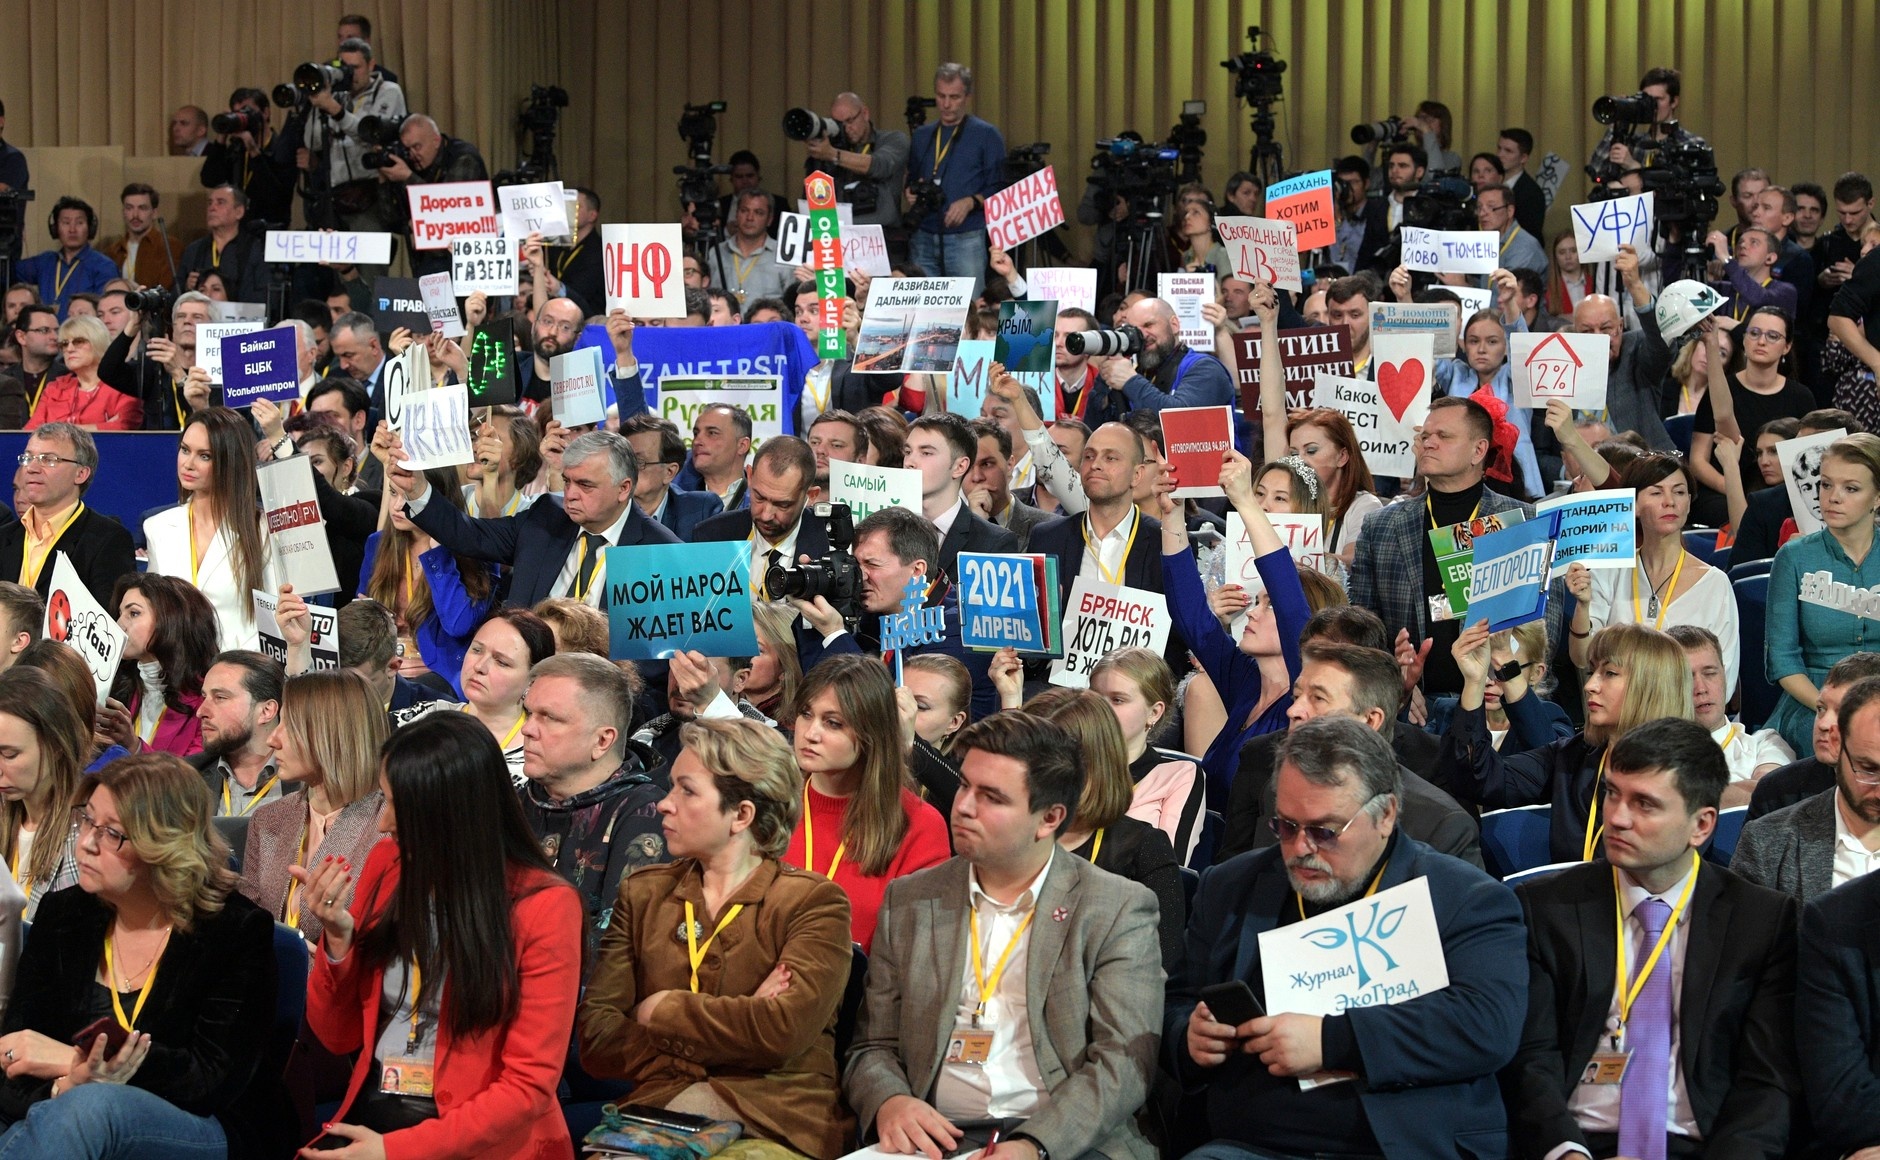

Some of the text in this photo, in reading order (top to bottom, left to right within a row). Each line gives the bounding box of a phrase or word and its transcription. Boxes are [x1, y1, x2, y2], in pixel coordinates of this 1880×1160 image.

[984, 165, 1057, 225] ЮЖНАЯ
[1268, 176, 1329, 200] АСТРАХАНЬ
[420, 195, 484, 213] Дорога в
[511, 194, 553, 211] BRICS
[1276, 200, 1320, 220] ХОТИМ
[415, 215, 496, 241] Грузию!!!
[524, 217, 543, 232] TV
[990, 196, 1065, 252] ОСЕТИЯ
[1295, 218, 1329, 235] ШАТЬ
[1573, 196, 1650, 254] УФА
[276, 233, 358, 261] ЧЕЧНЯ
[453, 239, 506, 256] НОВАЯ
[842, 236, 884, 261] УРГАН
[1404, 247, 1439, 266] СЛОВО
[1442, 241, 1498, 259] ТЮМЕНЬ
[454, 258, 513, 281] ГАЗЕТА
[605, 241, 671, 299] ОНФ
[1237, 244, 1278, 285] ДВ
[818, 216, 839, 351] БЕЛРУСИНФО
[892, 279, 950, 291] РАЗВИВАЕМ
[1170, 287, 1205, 296] БОЛЬНИЦА
[1171, 277, 1204, 286] СЕЛЬСКАЯ
[875, 293, 963, 308] ДАЛЬНИЙ ВОСТОК
[1387, 306, 1396, 317] В
[997, 318, 1033, 335] КРЫМ
[240, 340, 275, 354] Байкал
[1243, 332, 1342, 361] ПТИН
[244, 360, 273, 376] БЦБК
[1535, 361, 1567, 391] 2%
[226, 380, 296, 398] Усольехимпром
[403, 389, 472, 463] IRAN
[1359, 440, 1410, 456] оим?
[843, 473, 887, 493] САМЫЙ
[1560, 522, 1630, 540] АТОРИЙ НА
[964, 558, 1027, 610] 2021
[1472, 548, 1543, 597] БЕЛГОРОД
[612, 570, 744, 607] МОЙ НАРОД
[1079, 592, 1155, 628] БРЯНСК.
[627, 607, 734, 641] ЖДЕТ ВАС
[970, 615, 1032, 642] АПРЕЛЬ
[1071, 615, 1115, 652] ХОТЬ
[85, 622, 112, 663] Гав!
[1288, 963, 1356, 992] Журнал
[1335, 978, 1420, 1013] ЭкоГрад
